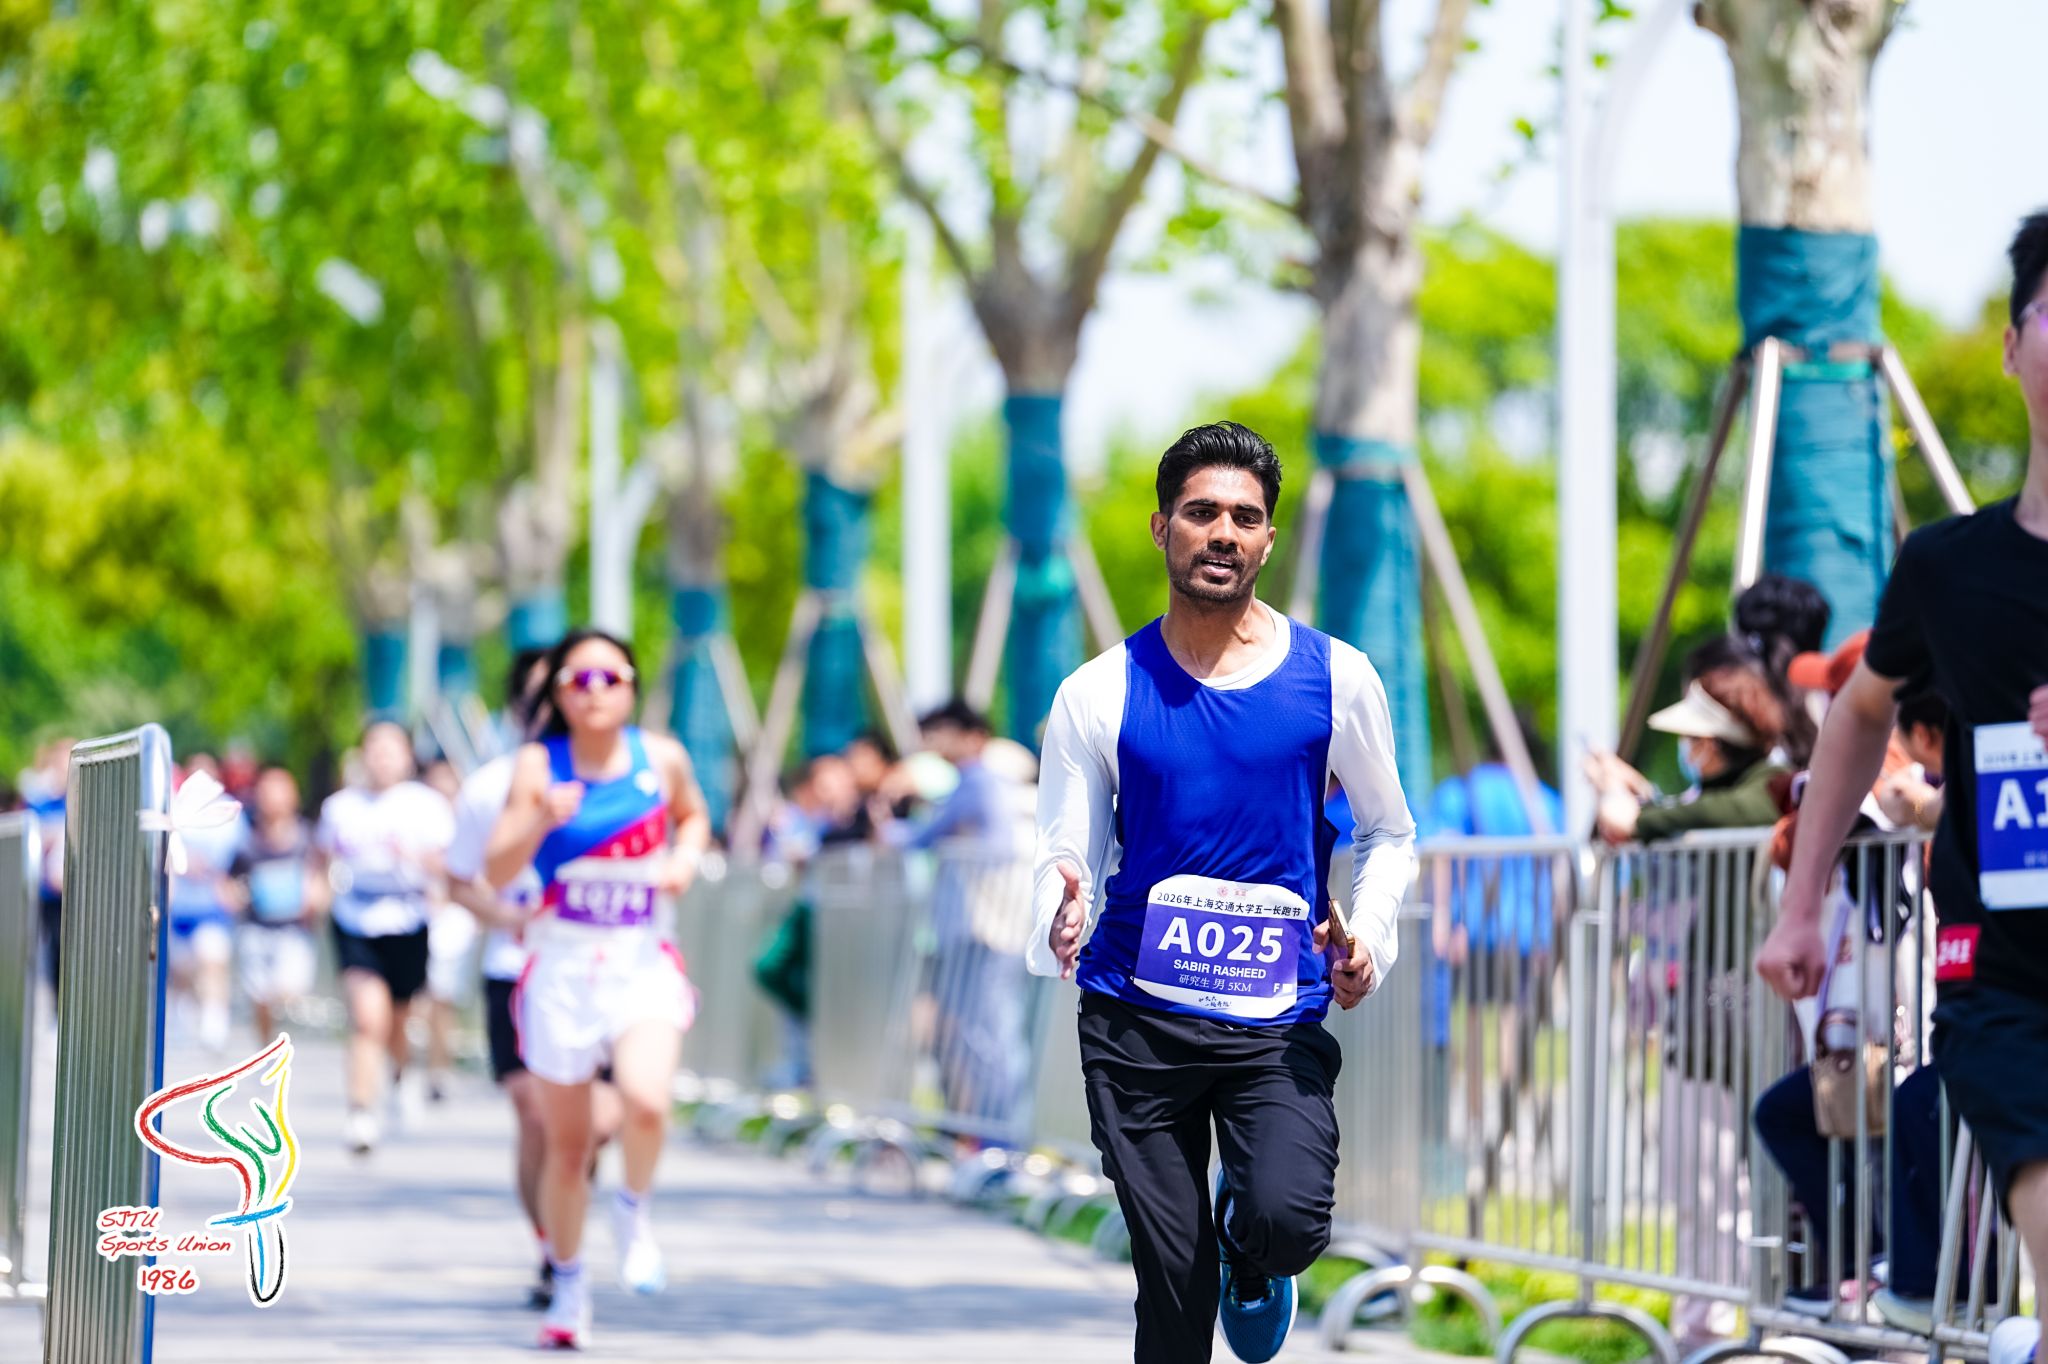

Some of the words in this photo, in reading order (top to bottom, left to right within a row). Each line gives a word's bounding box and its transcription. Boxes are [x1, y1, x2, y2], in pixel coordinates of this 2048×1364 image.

[1157, 892, 1302, 917] 2026年上海交通大学五一长跑节
[1158, 916, 1284, 963] A025
[1174, 959, 1210, 974] SABIR
[1213, 965, 1267, 979] RASHEED
[1178, 974, 1210, 989] 研究生
[1213, 978, 1225, 990] 男
[1228, 982, 1252, 993] 5KM
